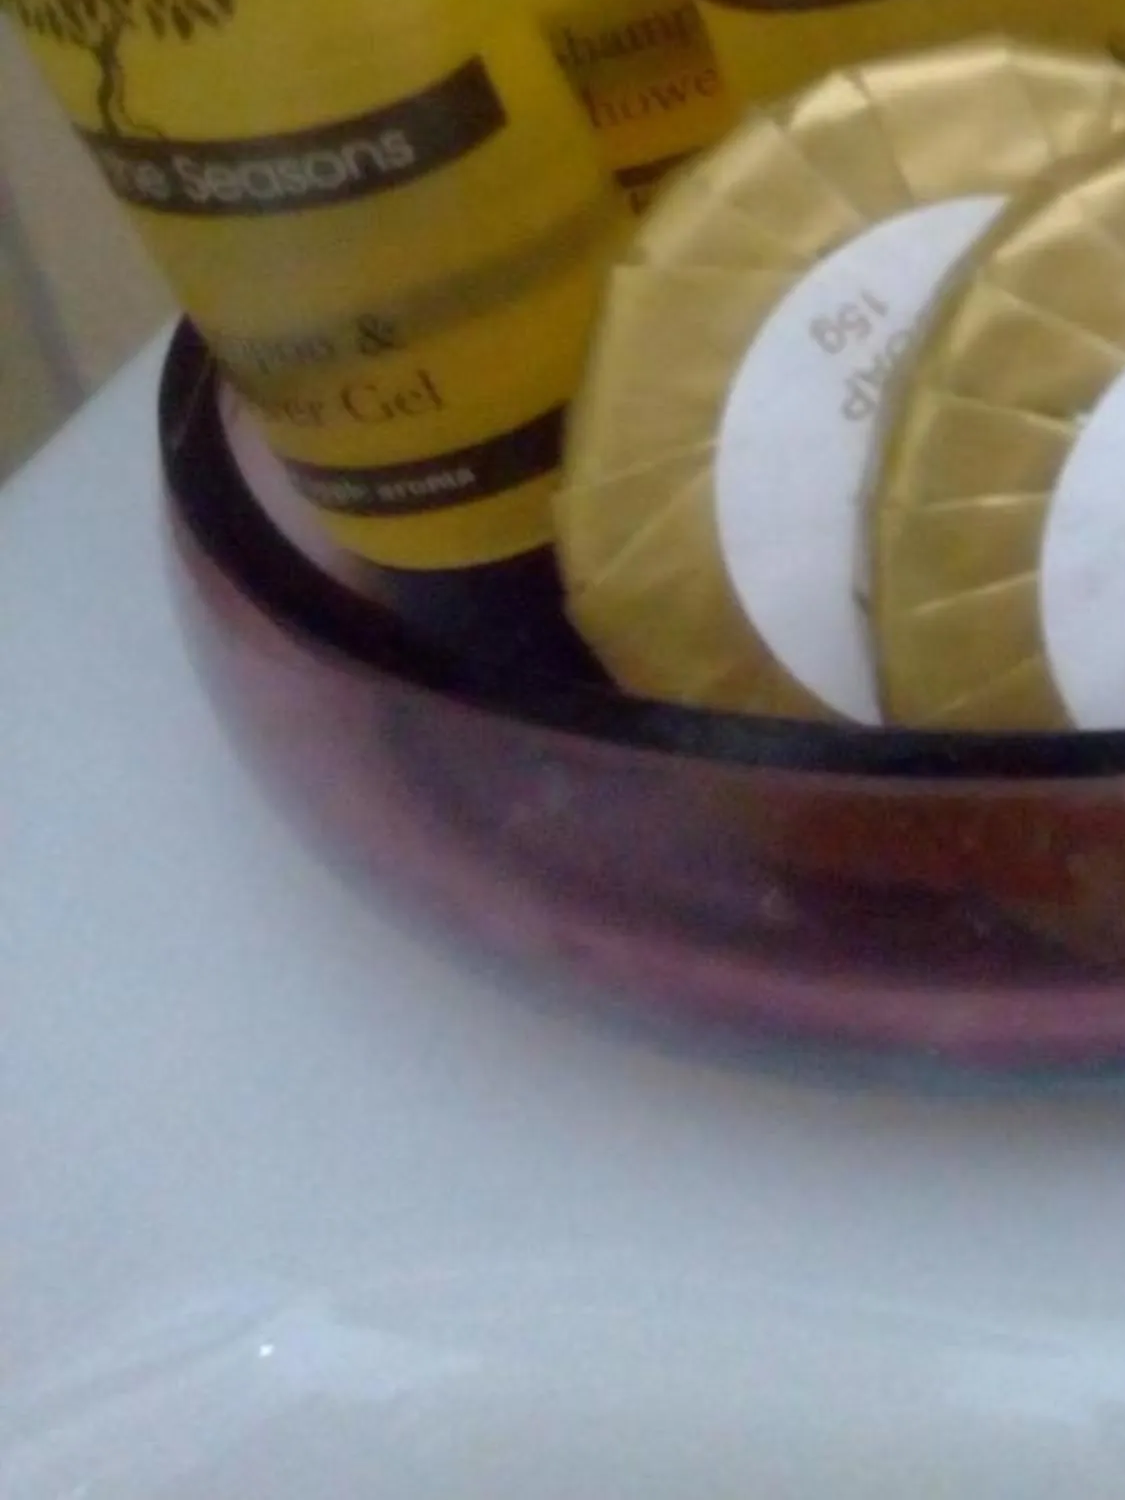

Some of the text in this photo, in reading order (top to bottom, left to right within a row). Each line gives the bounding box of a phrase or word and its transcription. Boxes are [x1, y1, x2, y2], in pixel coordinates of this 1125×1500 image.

[171, 128, 417, 203] Seasons
[355, 312, 408, 357] &
[807, 286, 890, 356] 15g
[340, 366, 447, 424] Gel
[840, 328, 914, 422] OAP
